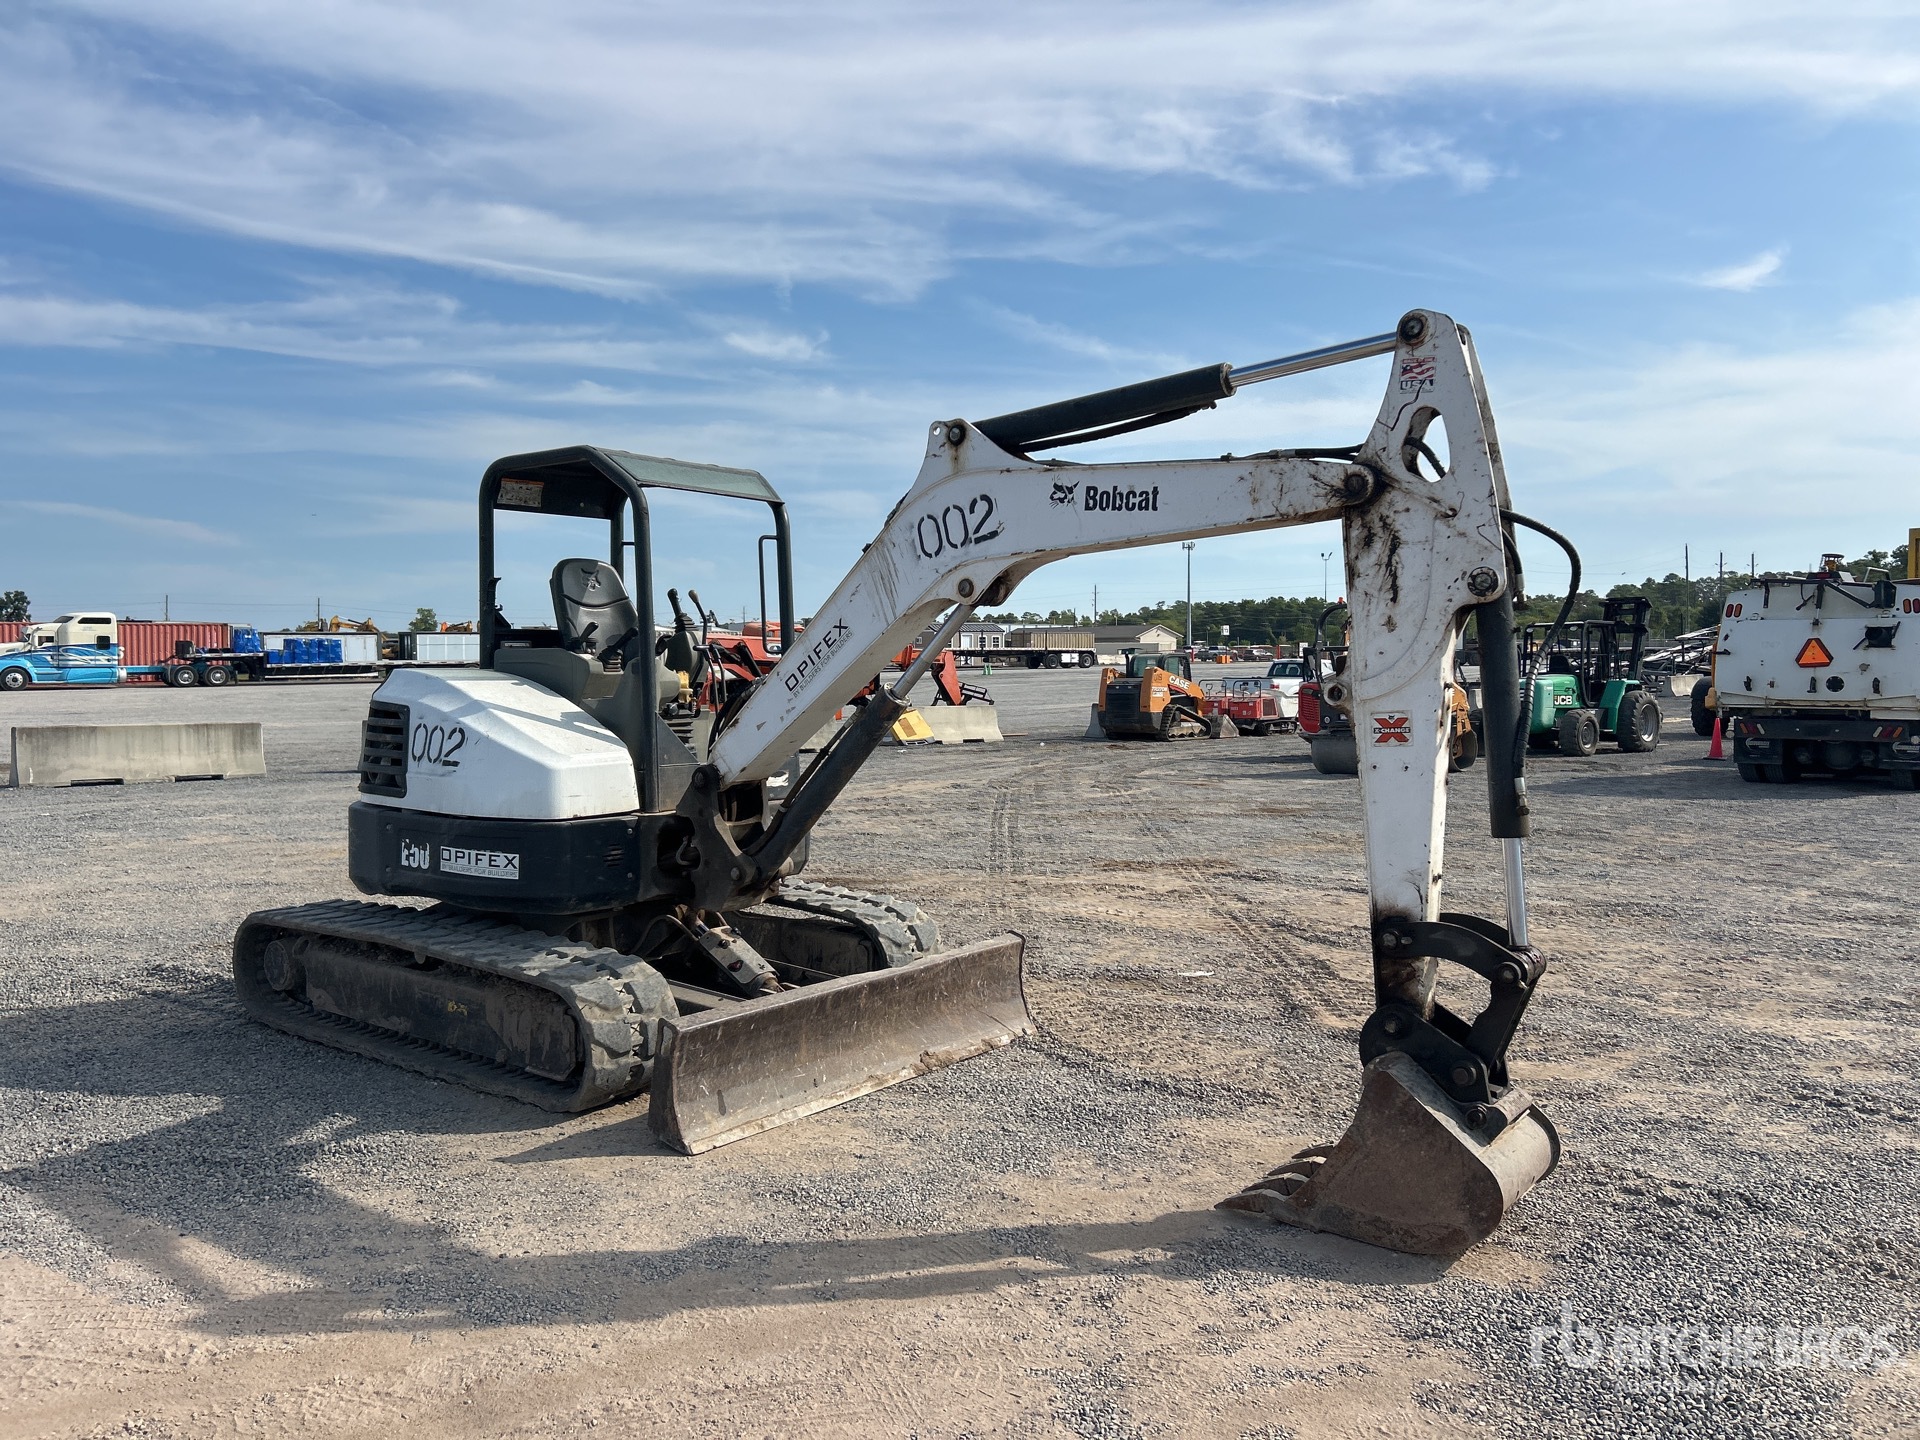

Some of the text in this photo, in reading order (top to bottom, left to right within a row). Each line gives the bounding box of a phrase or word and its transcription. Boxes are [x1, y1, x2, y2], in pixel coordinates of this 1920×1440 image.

[1084, 485, 1159, 512] Bobcat
[917, 494, 1000, 559] 002
[785, 618, 848, 691] OPIFEX
[1169, 675, 1190, 690] CASE
[1554, 695, 1573, 705] JCB
[411, 722, 467, 767] 002
[441, 848, 518, 869] OPIFEX
